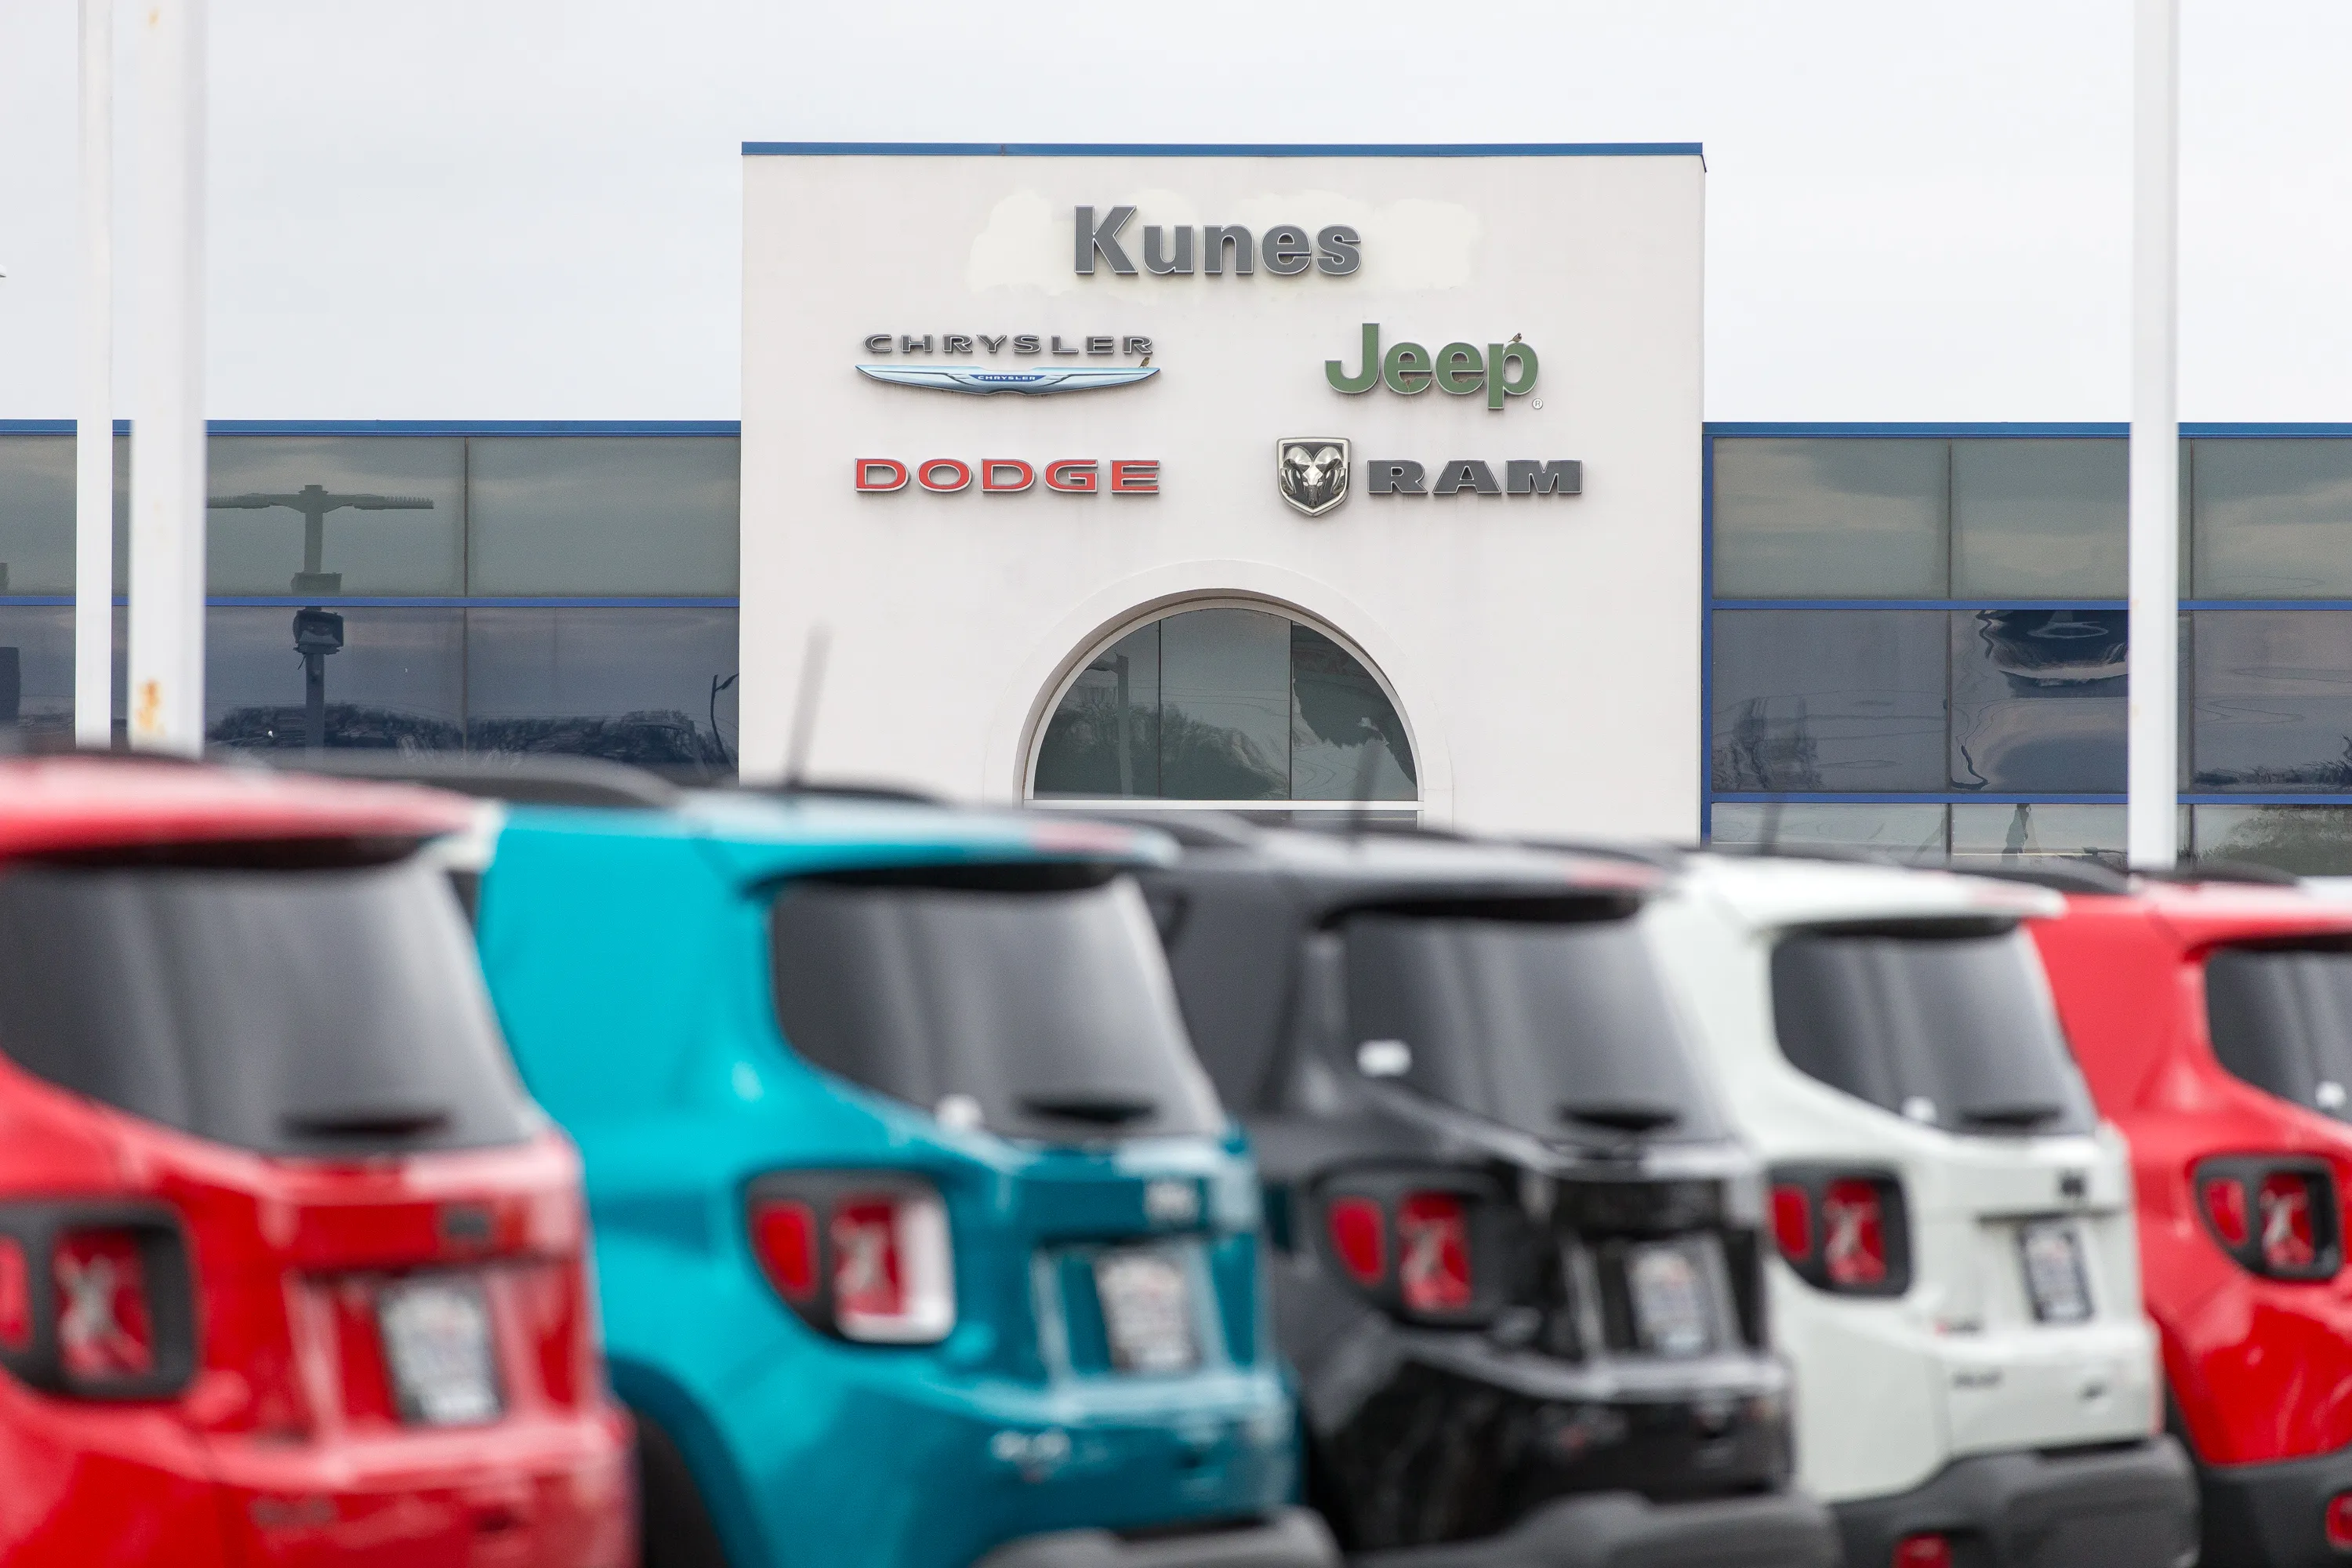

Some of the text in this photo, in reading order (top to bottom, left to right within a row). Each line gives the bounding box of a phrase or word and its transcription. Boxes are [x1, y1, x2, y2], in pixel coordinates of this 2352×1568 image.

[1074, 205, 1361, 274] Kunes
[864, 334, 1152, 354] CHRYSLER
[1325, 322, 1539, 409] Jeep
[855, 458, 1160, 494] DODGE
[1367, 459, 1583, 494] RAM
